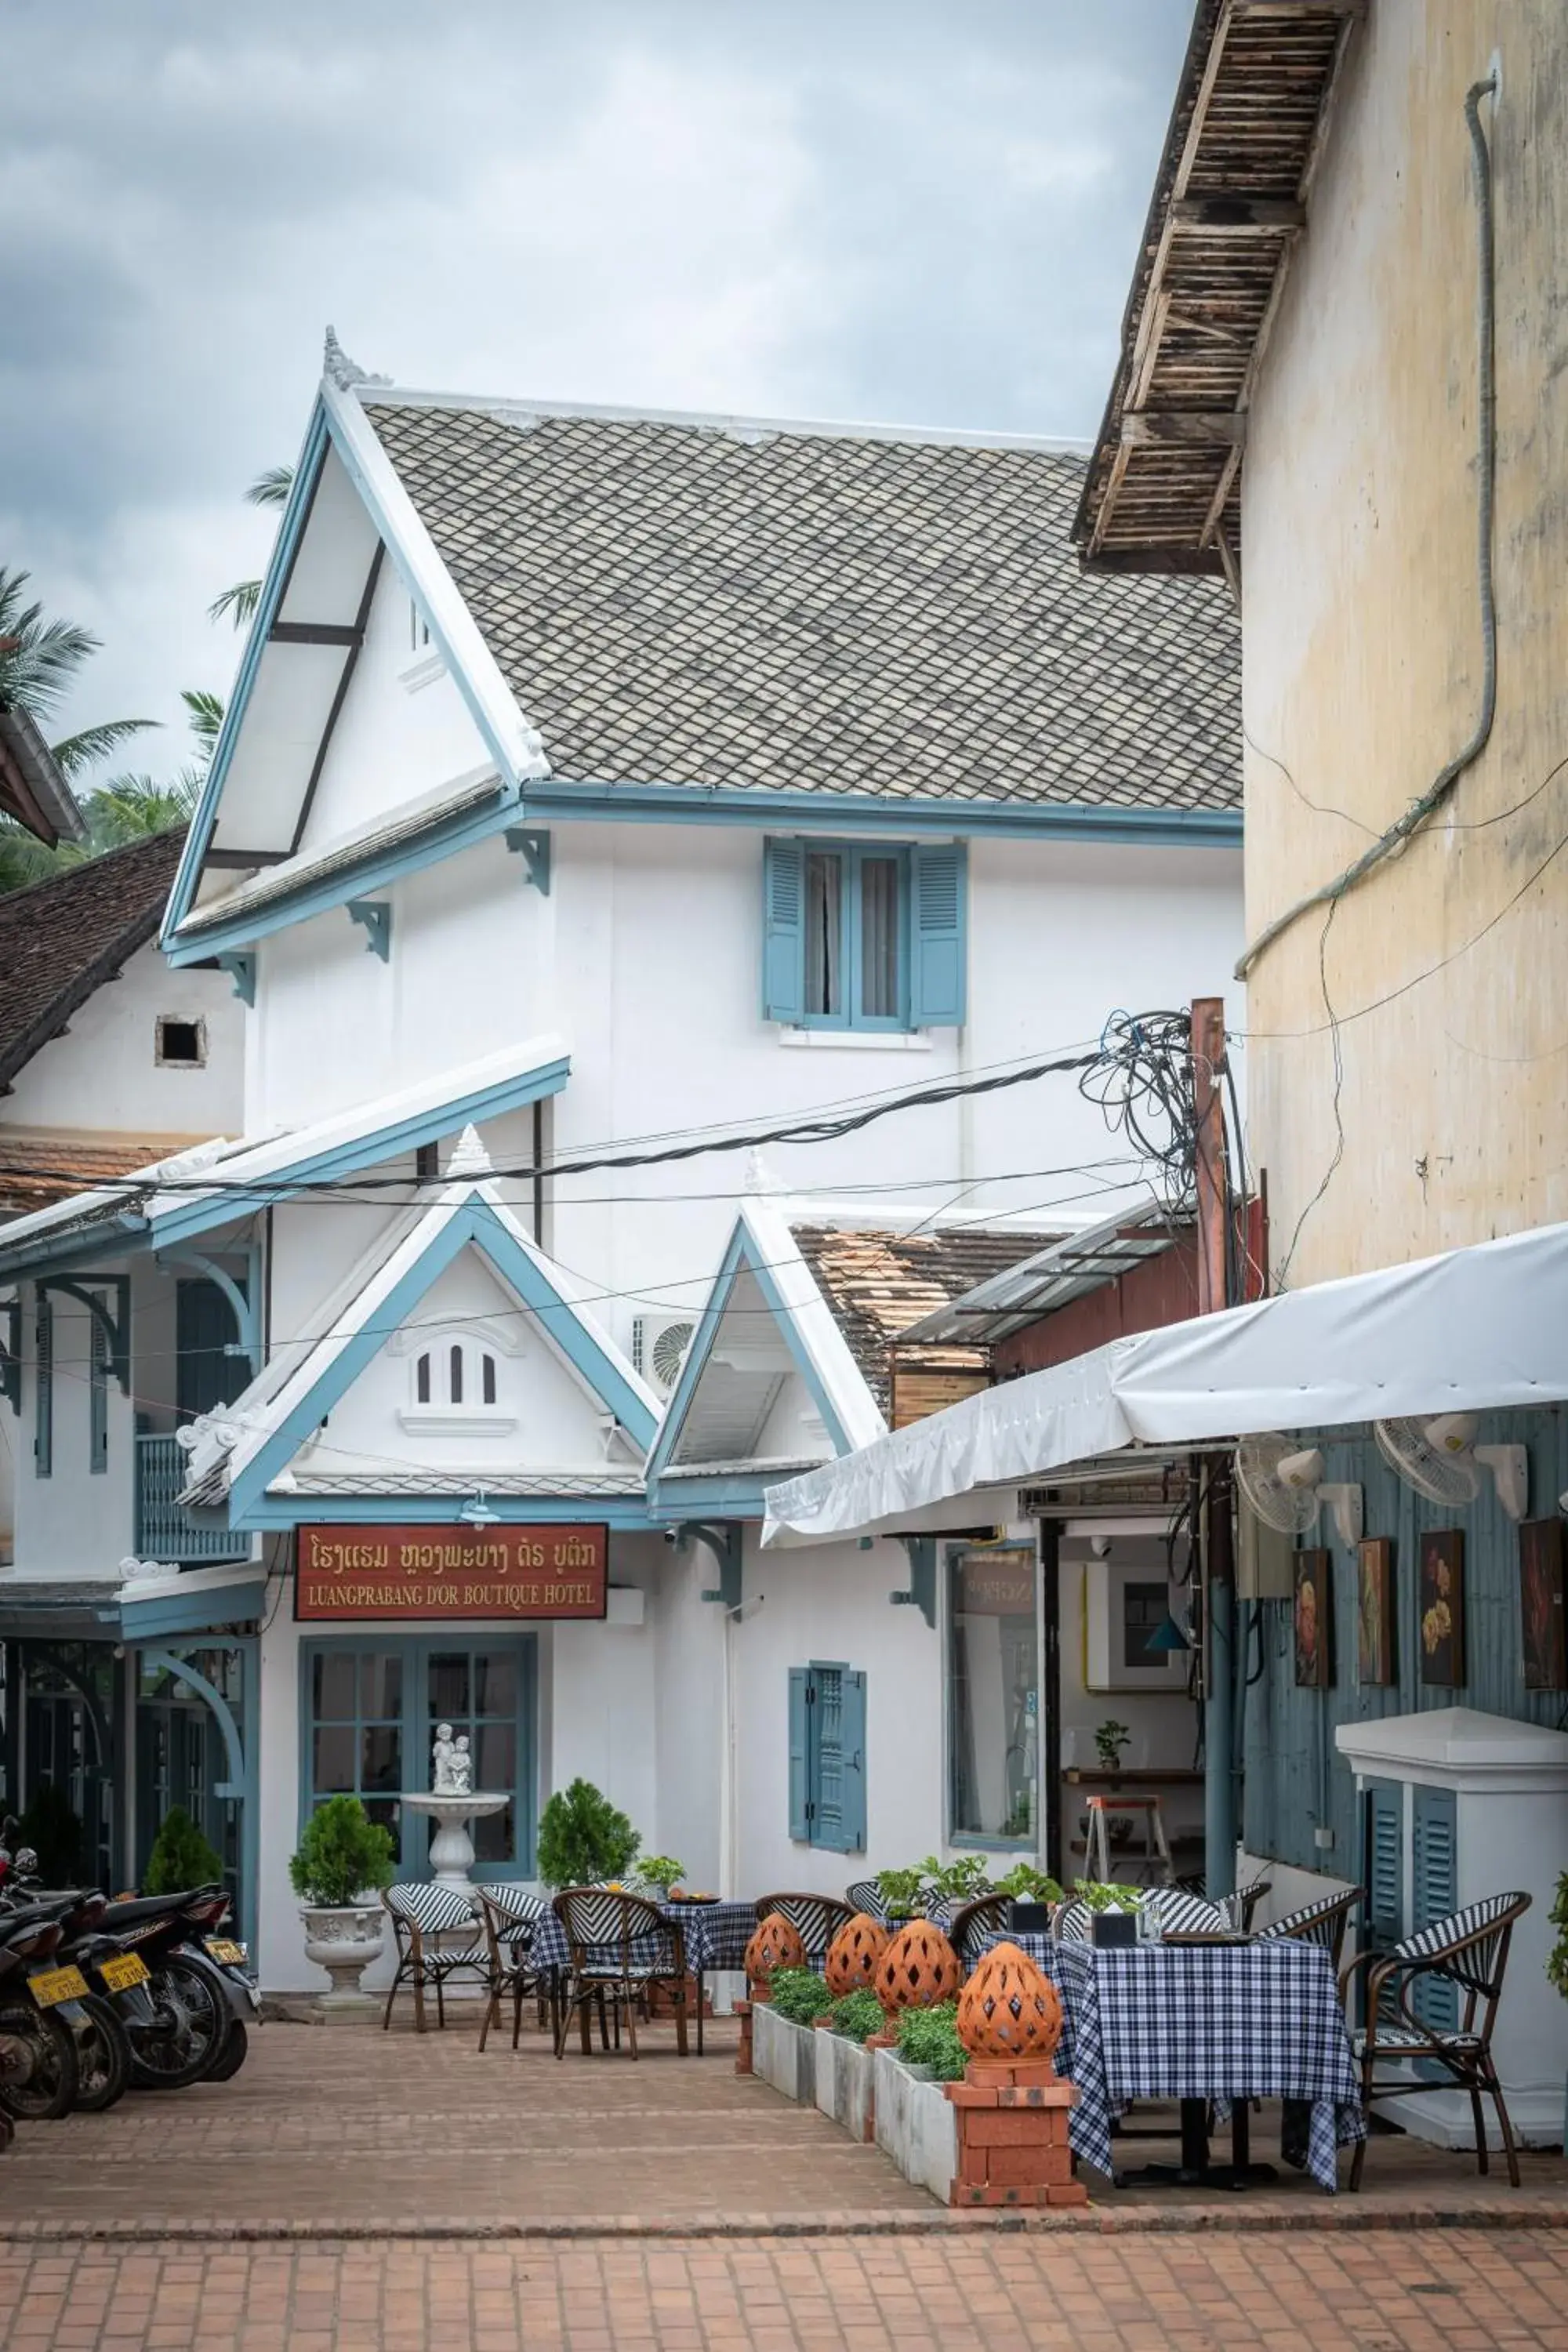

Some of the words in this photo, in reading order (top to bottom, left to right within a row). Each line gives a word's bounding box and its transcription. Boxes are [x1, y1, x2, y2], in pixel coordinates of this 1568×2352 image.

[310, 1534, 389, 1574] ໂຮງແຮມ
[308, 1584, 422, 1606] LUANGPRABANG
[426, 1584, 459, 1606] D'OR
[463, 1584, 539, 1611] BOUTIQUE
[543, 1584, 597, 1605] HOTEL
